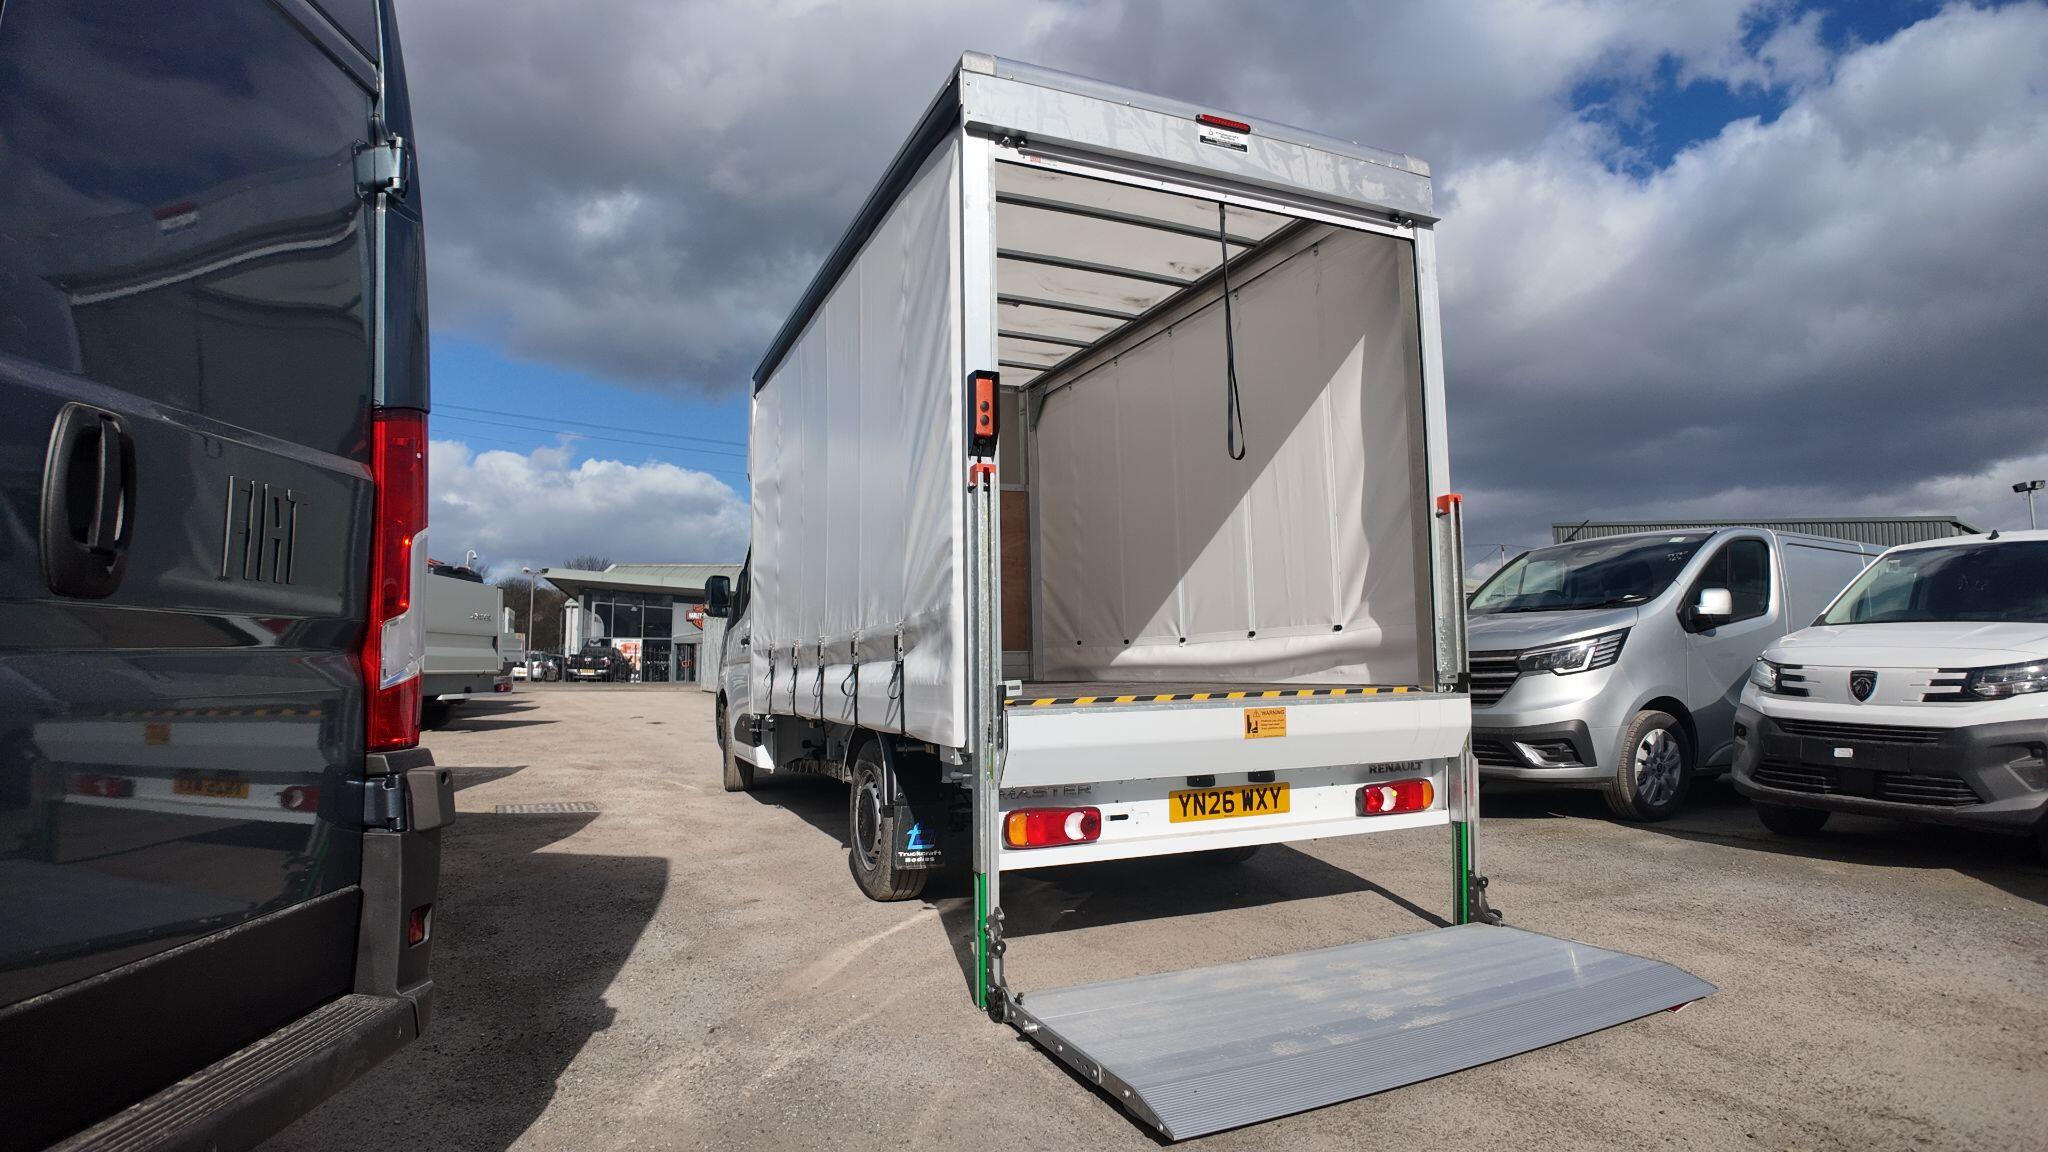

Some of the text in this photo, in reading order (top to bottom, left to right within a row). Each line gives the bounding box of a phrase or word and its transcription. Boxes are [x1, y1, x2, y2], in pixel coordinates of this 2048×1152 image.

[1368, 761, 1423, 774] RENAULT
[1178, 786, 1281, 817] YN26 WXY
